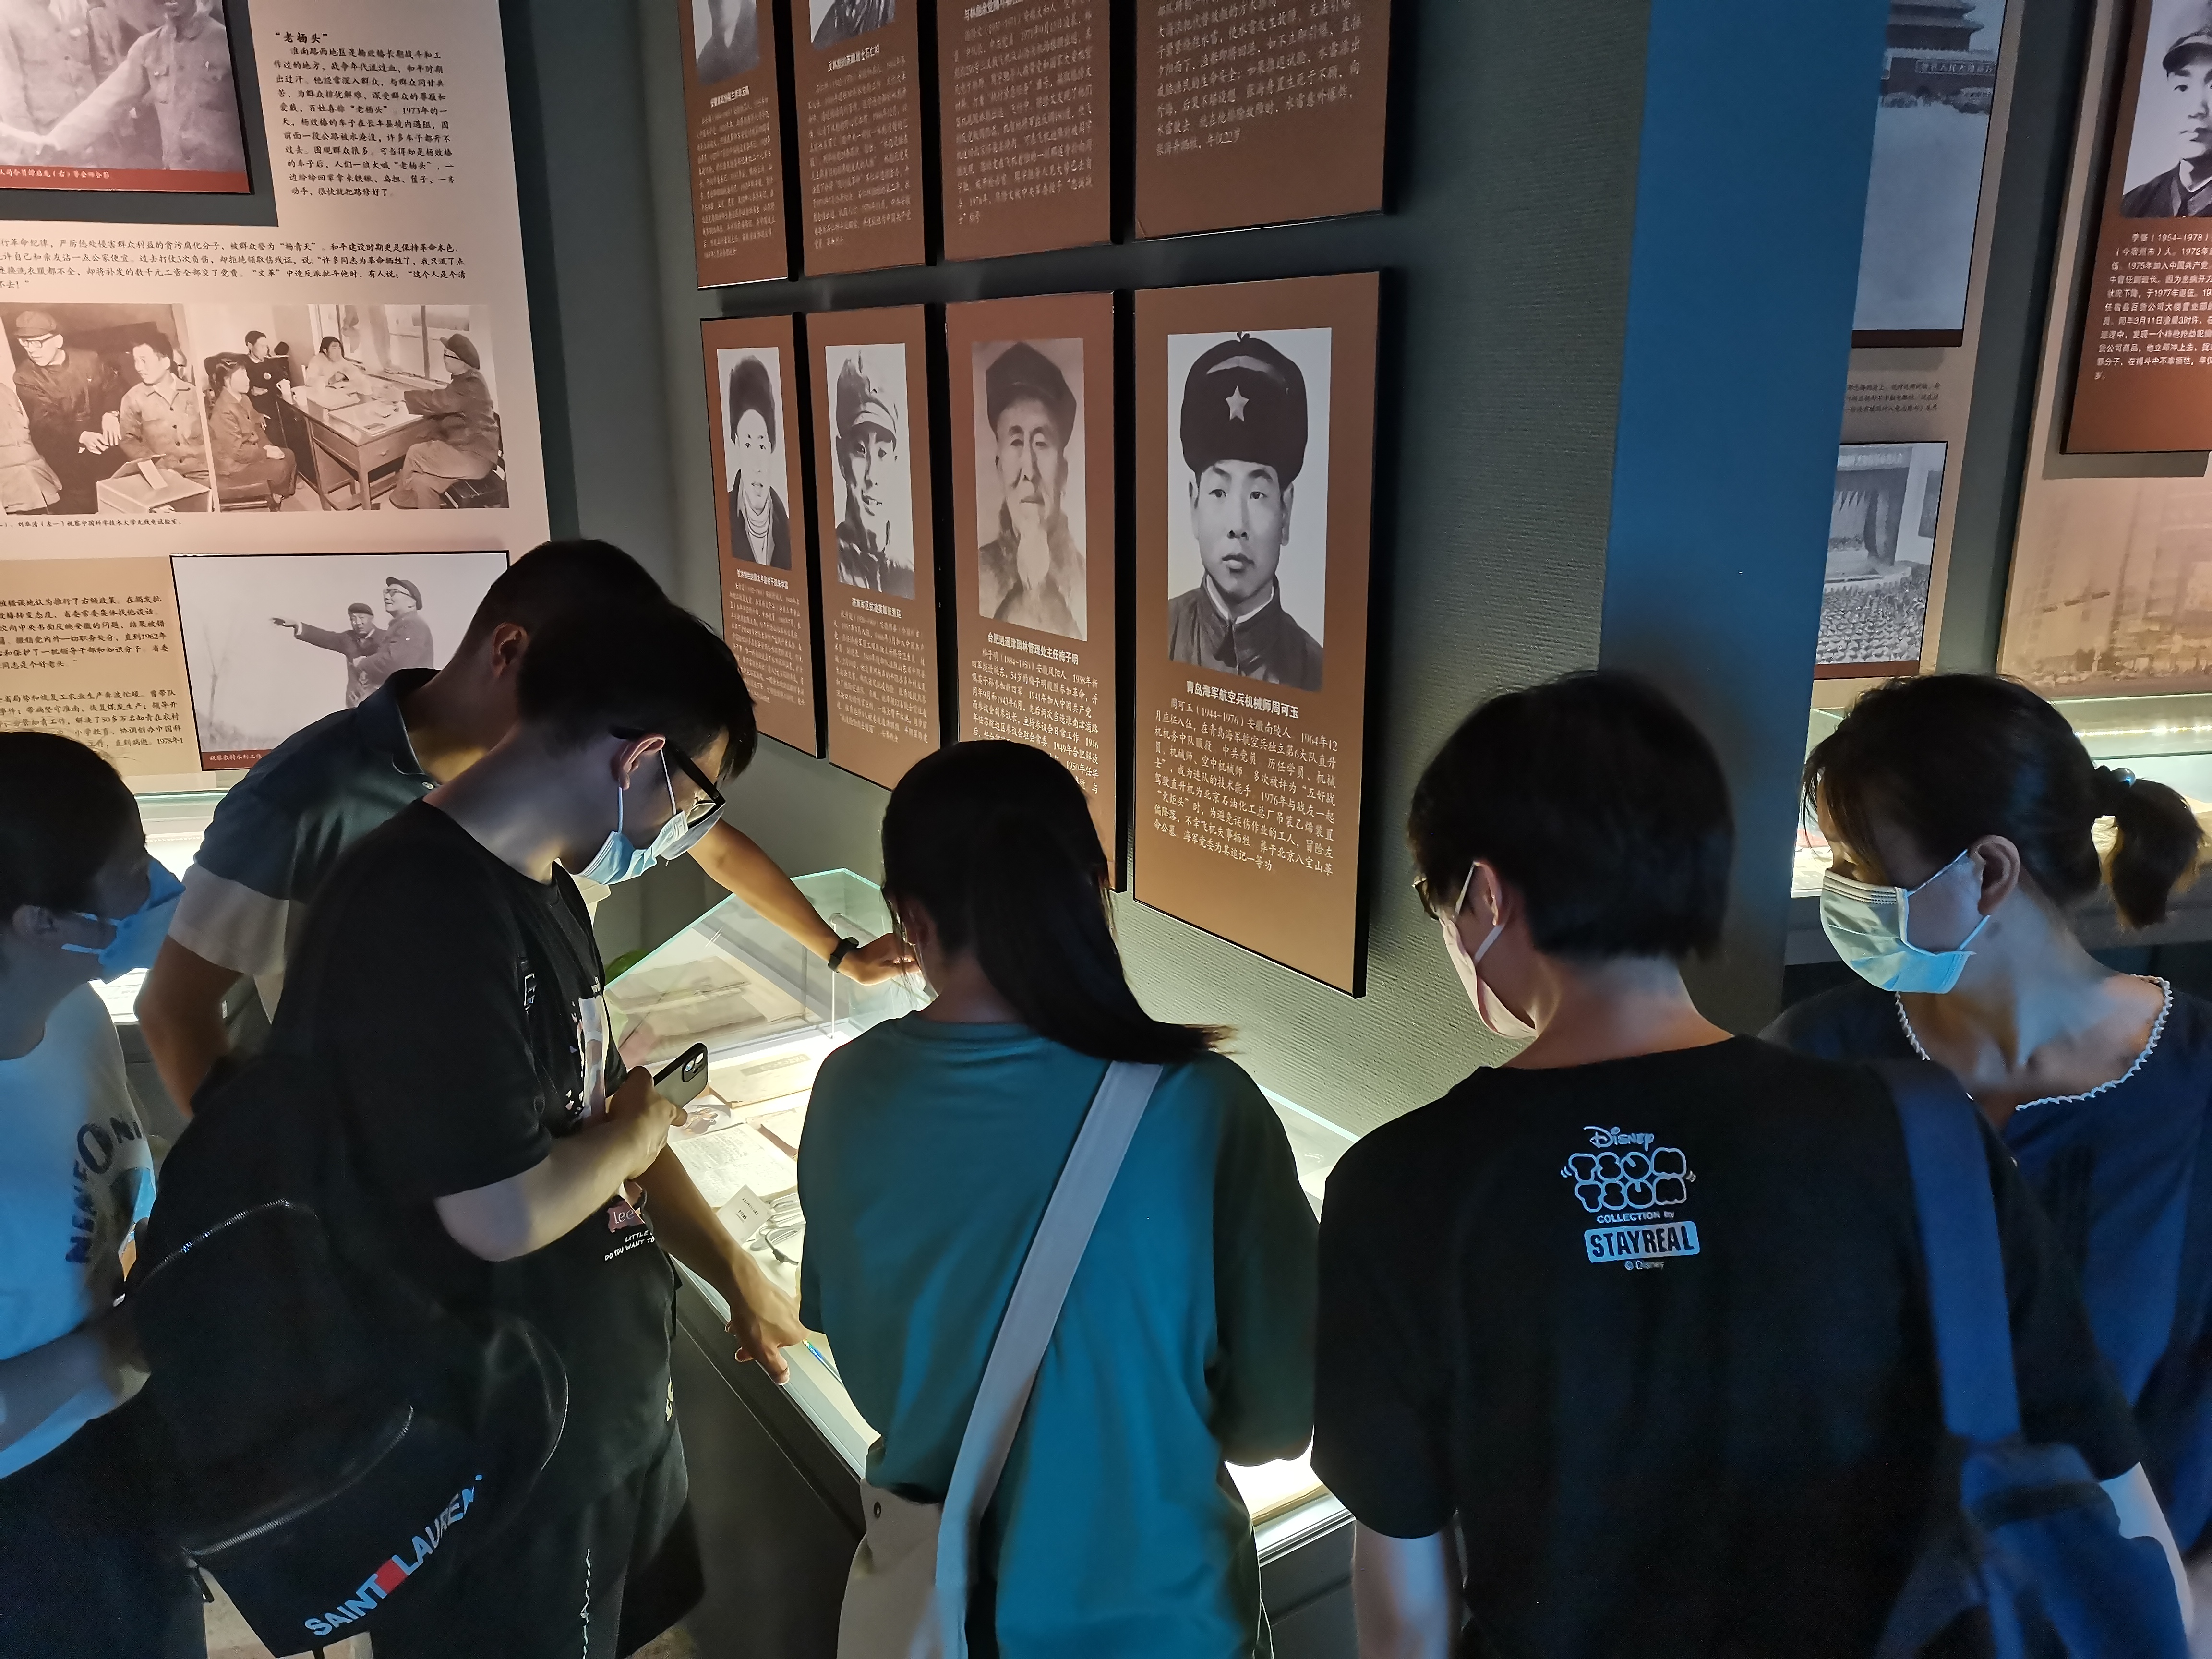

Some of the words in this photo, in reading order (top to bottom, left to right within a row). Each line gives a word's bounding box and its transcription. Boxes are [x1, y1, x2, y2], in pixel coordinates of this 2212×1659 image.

[1186, 680, 1299, 720] 青岛海军航空兵机械师周可玉
[1596, 1211, 1661, 1224] COLLECTION
[604, 1252, 613, 1261] DO
[625, 1239, 645, 1250] WANT
[625, 1230, 649, 1243] LITTLE
[1590, 1226, 1695, 1258] STAYREAL
[304, 1573, 388, 1636] SAINT
